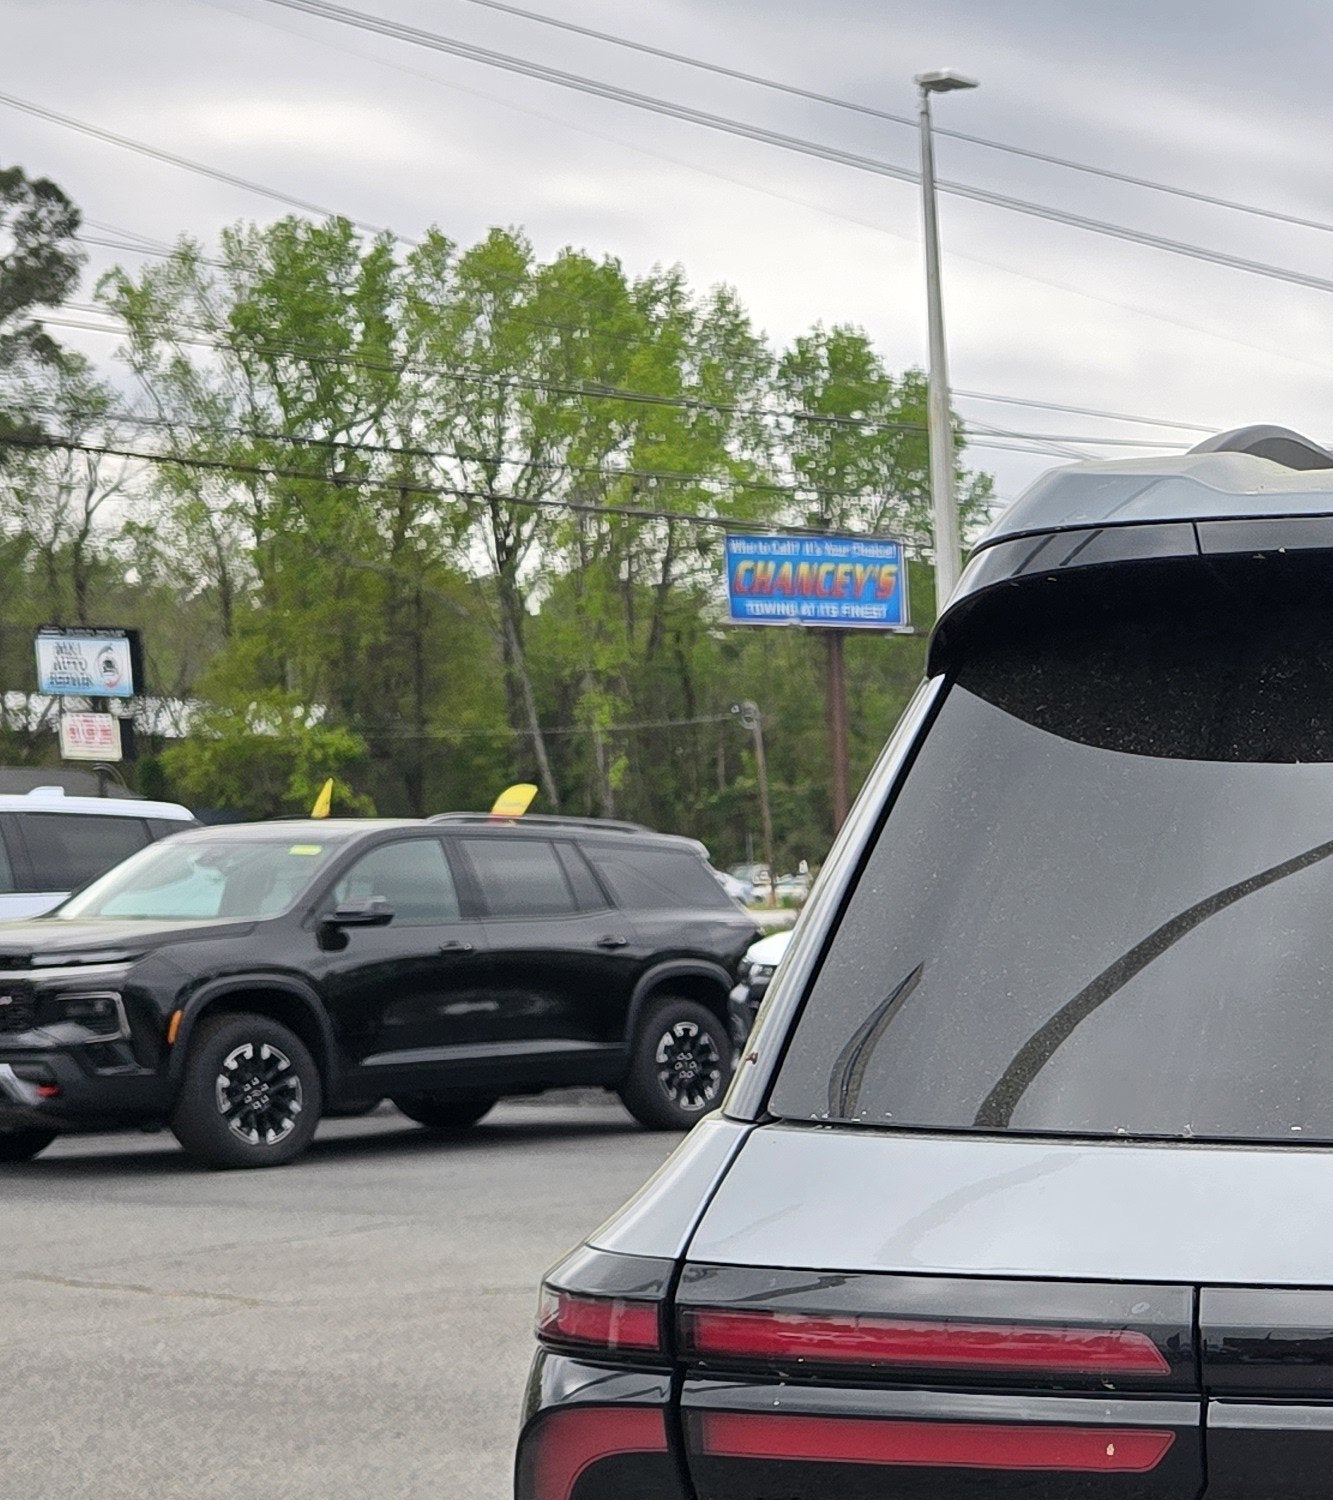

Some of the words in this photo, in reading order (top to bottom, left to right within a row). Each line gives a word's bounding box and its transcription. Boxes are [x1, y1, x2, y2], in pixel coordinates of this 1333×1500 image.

[733, 560, 897, 599] CHANCEY'S
[746, 600, 797, 616] TOWING
[841, 603, 887, 618] FINEST
